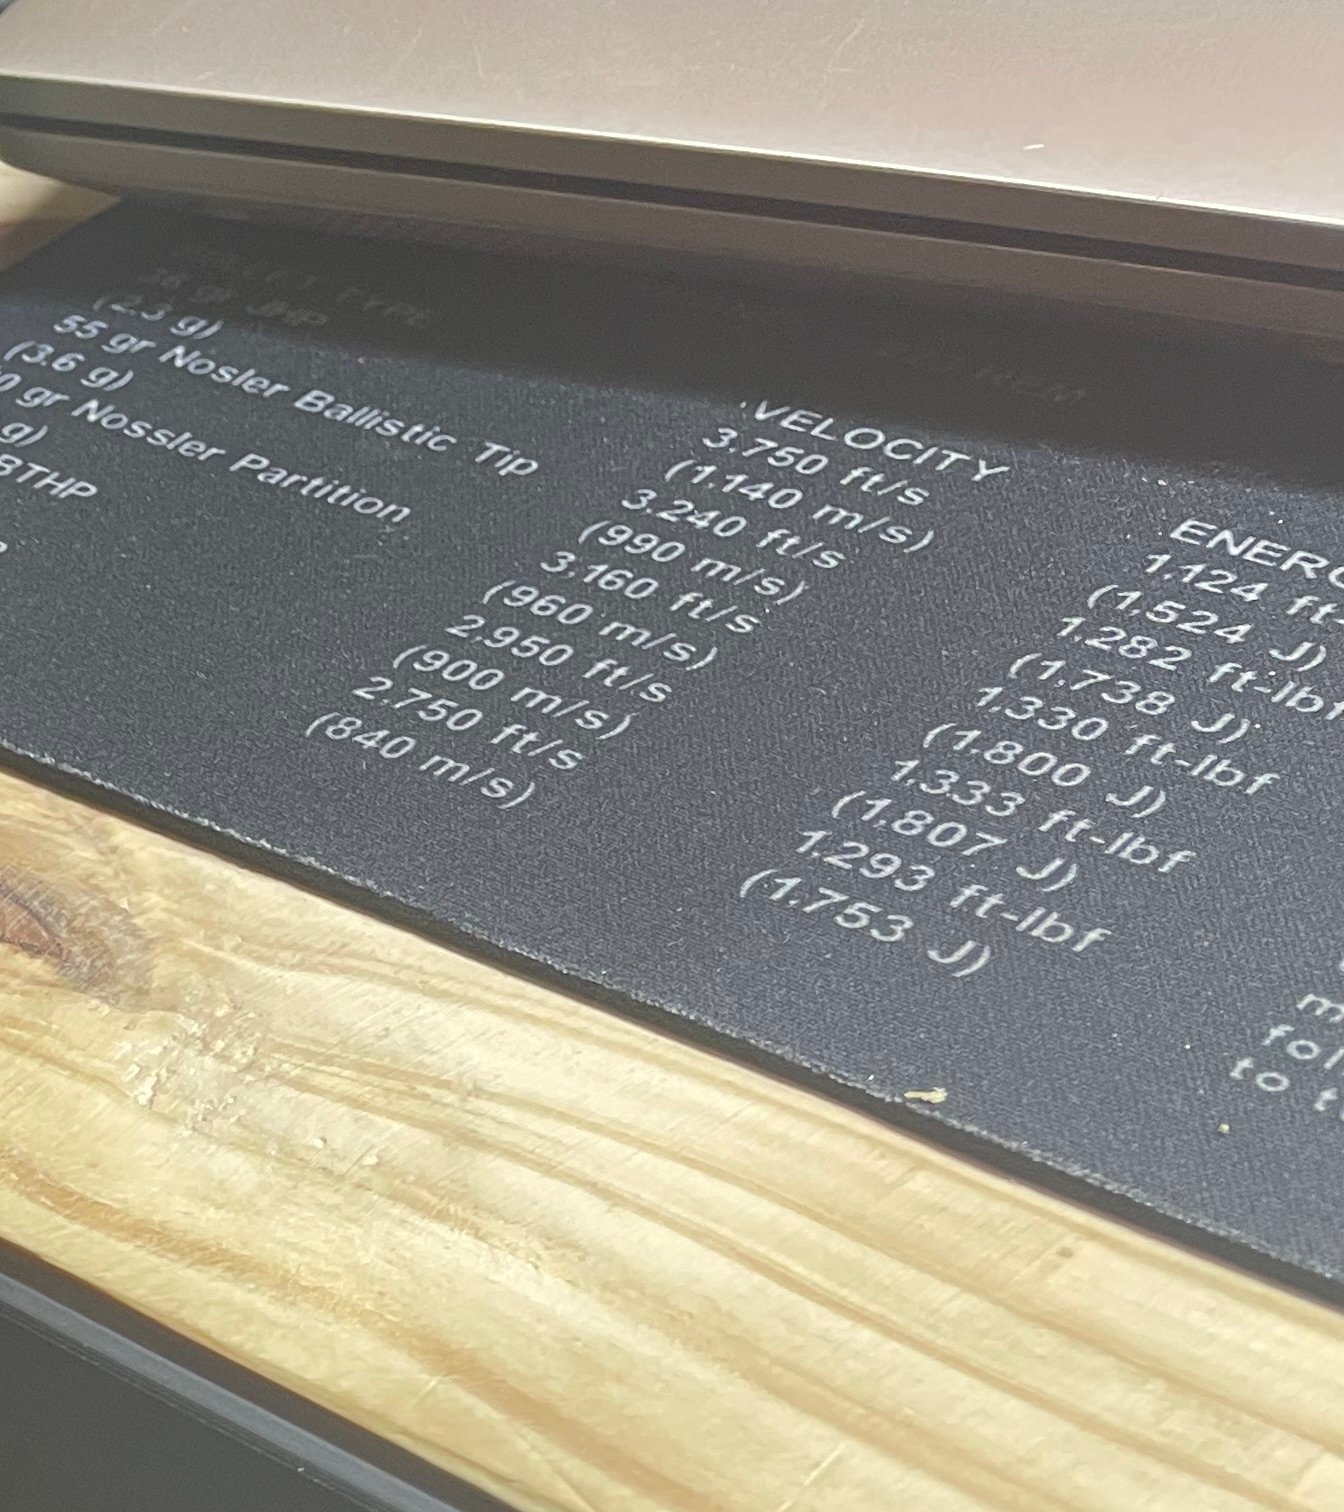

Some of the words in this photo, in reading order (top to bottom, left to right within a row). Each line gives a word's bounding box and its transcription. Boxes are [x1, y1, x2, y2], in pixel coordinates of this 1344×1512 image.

[170, 315, 225, 339] g)
[3, 340, 85, 372] (3.6
[80, 366, 134, 391] g)
[53, 315, 109, 339] 55
[102, 333, 156, 354] gr
[159, 345, 290, 397] Nosler
[293, 390, 457, 451] Ballistic
[475, 441, 539, 477] Tip
[15, 387, 70, 408] gr
[71, 399, 226, 461] Nossler
[228, 453, 411, 523] Partition
[755, 401, 1010, 482] VELOCITY
[840, 466, 930, 506] ft/s
[756, 529, 846, 569] ft/s
[812, 505, 935, 553] m/s)
[578, 521, 685, 562] (990
[691, 557, 809, 605] m/s)
[482, 581, 593, 625] (960
[599, 622, 718, 671] m/s)
[670, 592, 760, 634] ft/s
[1268, 641, 1327, 672] J)
[392, 644, 505, 690] (900
[511, 686, 638, 740] m/s)
[582, 659, 672, 702] ft/s
[490, 724, 584, 770] ft/s
[1191, 713, 1250, 744] J)
[305, 711, 416, 759] (840
[419, 755, 535, 809] m/s)
[1125, 734, 1281, 795] ft-lbf
[1105, 786, 1166, 818] J)
[1038, 809, 1197, 874] ft-lbf
[1016, 858, 1080, 892] J)
[949, 884, 1112, 953] ft-lbf
[927, 940, 992, 978] J)
[1230, 1057, 1290, 1092] to
